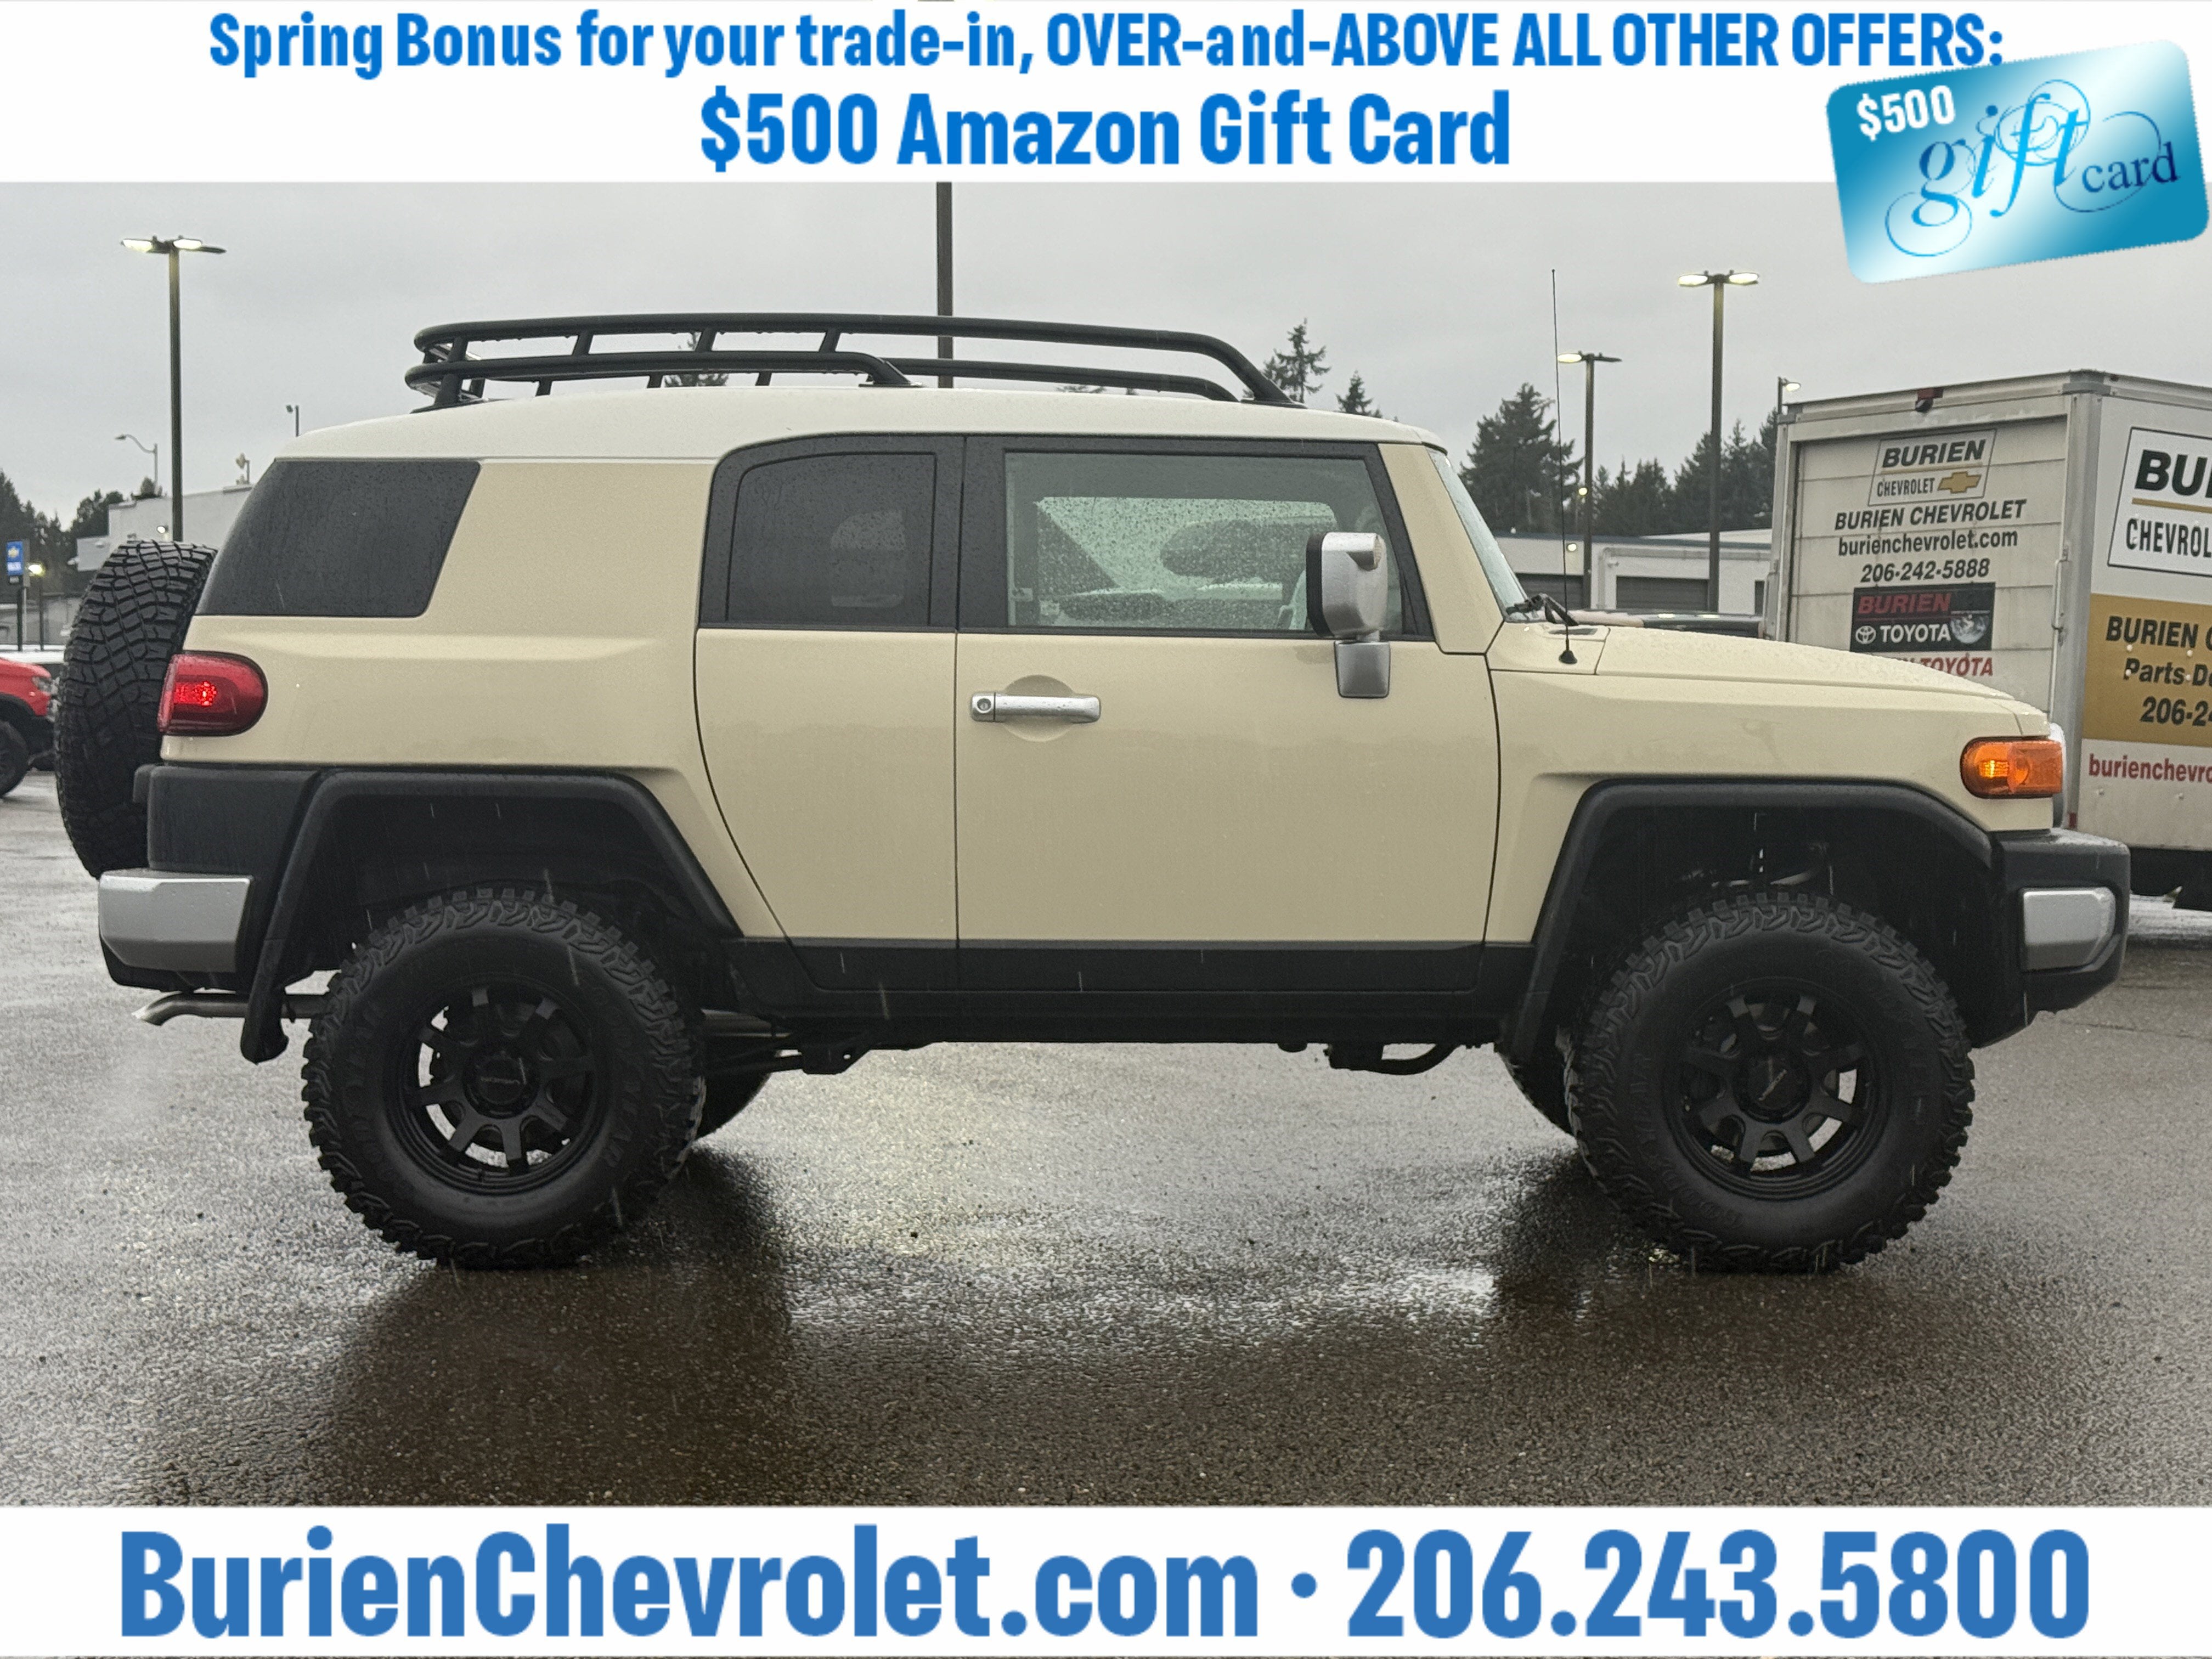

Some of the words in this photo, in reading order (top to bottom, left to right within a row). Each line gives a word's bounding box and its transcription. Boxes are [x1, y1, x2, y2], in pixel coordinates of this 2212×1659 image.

[1882, 439, 1987, 469] BURIEN
[1877, 478, 1935, 497] CHEVROLET
[1835, 507, 1905, 531] BURIEN
[1910, 499, 2027, 525] CHEVROLET
[1838, 529, 2018, 556] burienchevrolet.com
[2126, 517, 2212, 558] CHEVROL
[1860, 558, 1990, 583] 206-242-5888
[1858, 593, 1952, 614] BURIEN
[1880, 624, 1951, 643] TOYOTA
[2106, 615, 2199, 648] BURIEN
[2123, 657, 2186, 686] Parts
